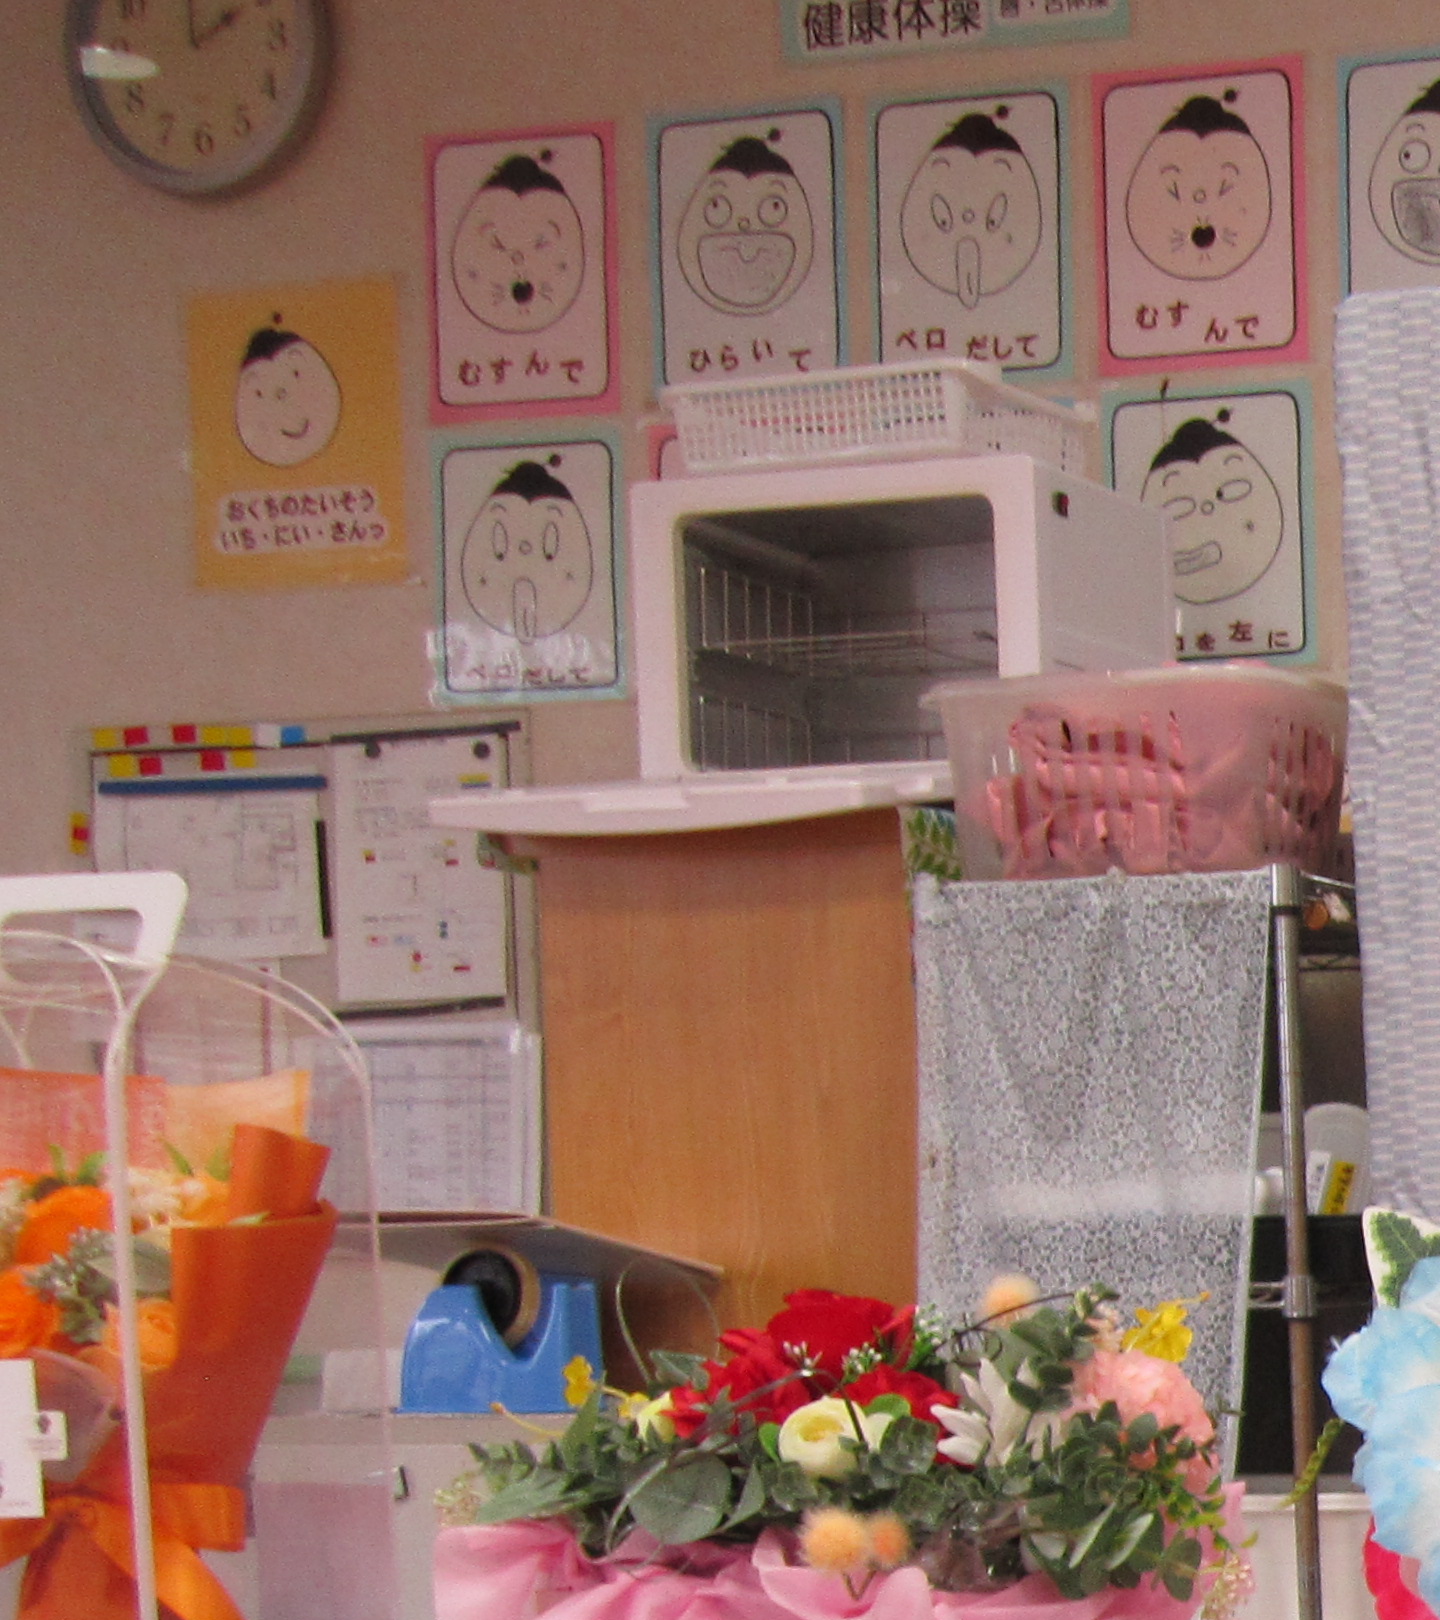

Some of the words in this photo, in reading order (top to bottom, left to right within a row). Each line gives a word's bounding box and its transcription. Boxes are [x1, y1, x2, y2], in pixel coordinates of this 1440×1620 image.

[806, 0, 982, 50] 健康体操
[689, 337, 812, 373] ひらいて
